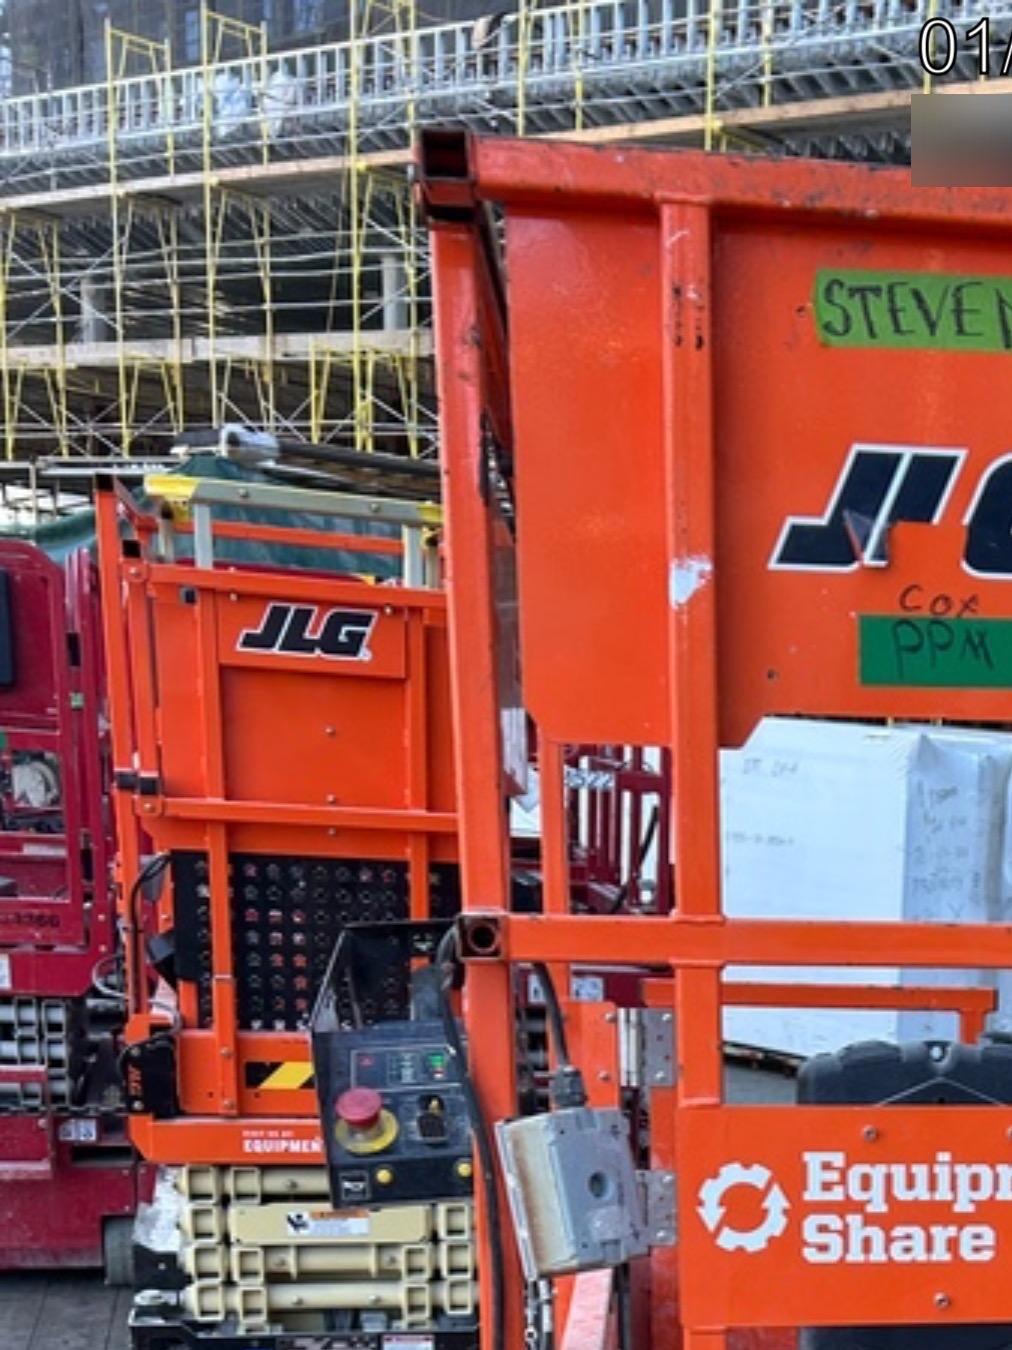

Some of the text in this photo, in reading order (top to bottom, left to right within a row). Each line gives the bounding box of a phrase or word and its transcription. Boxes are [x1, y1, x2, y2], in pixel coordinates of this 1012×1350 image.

[234, 602, 378, 661] JLG
[892, 619, 994, 678] PPM
[802, 1214, 996, 1264] Share
